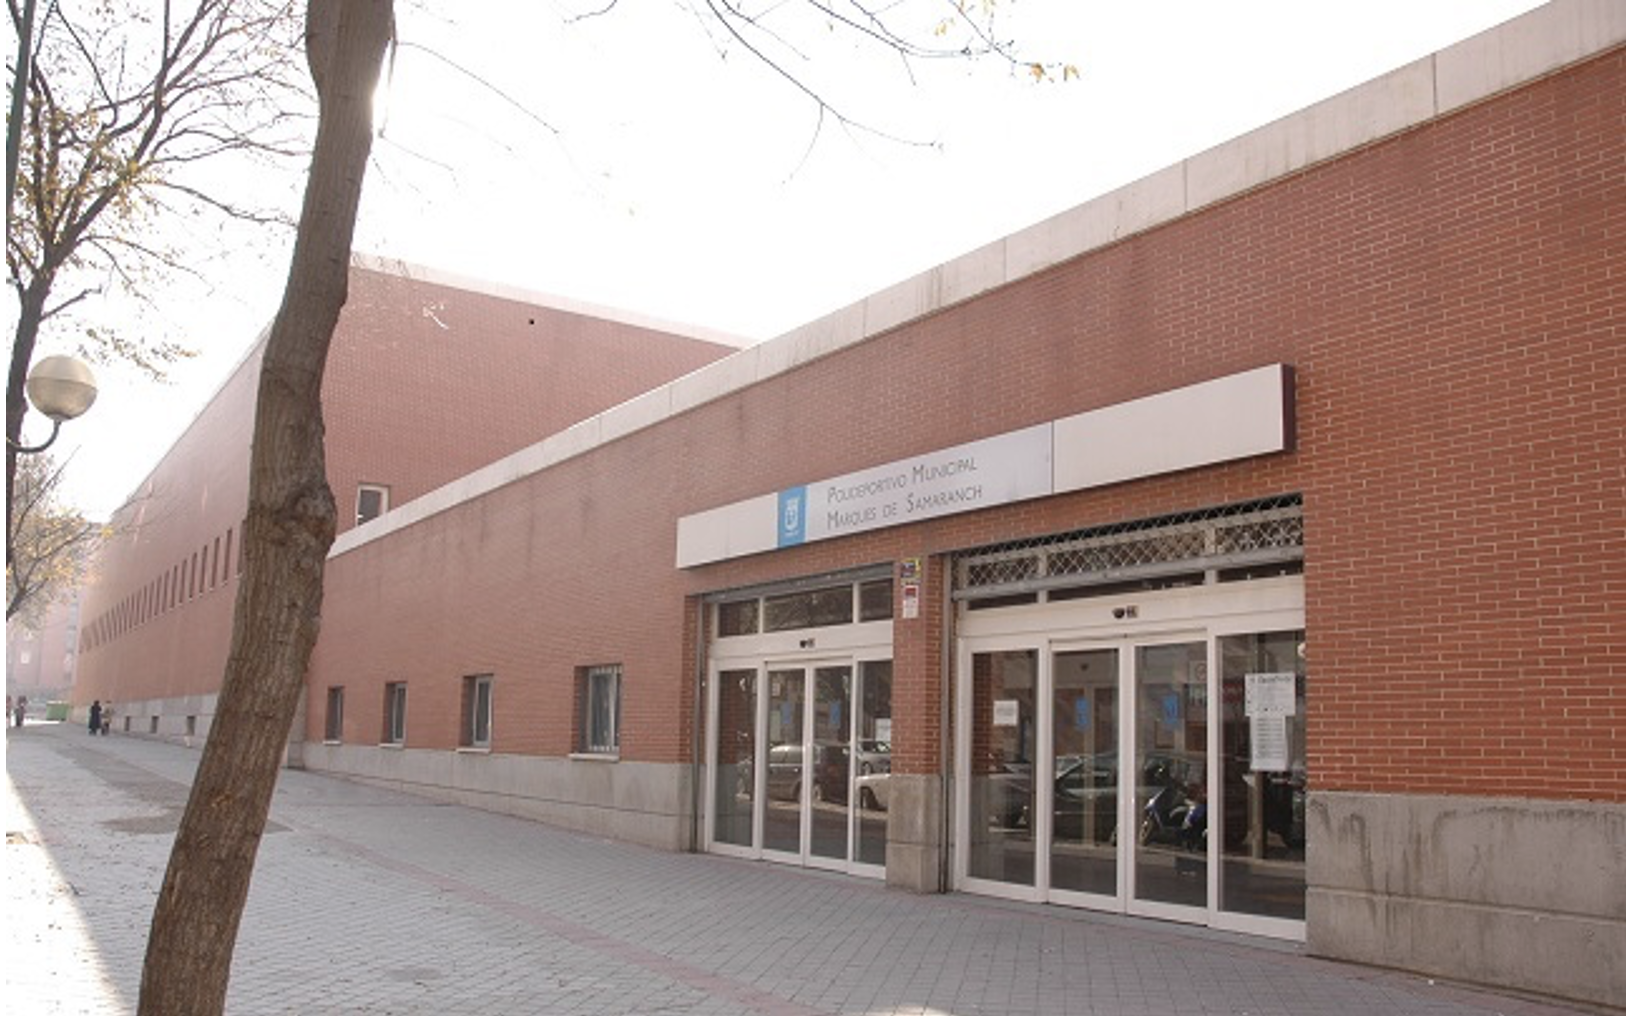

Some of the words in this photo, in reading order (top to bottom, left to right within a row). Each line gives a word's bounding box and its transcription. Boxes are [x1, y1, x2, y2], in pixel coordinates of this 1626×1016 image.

[827, 474, 907, 503] POLIDEPORTIVO
[912, 457, 978, 484] MUNICIPAL
[883, 502, 899, 517] DE
[906, 485, 983, 513] SAMARANCH
